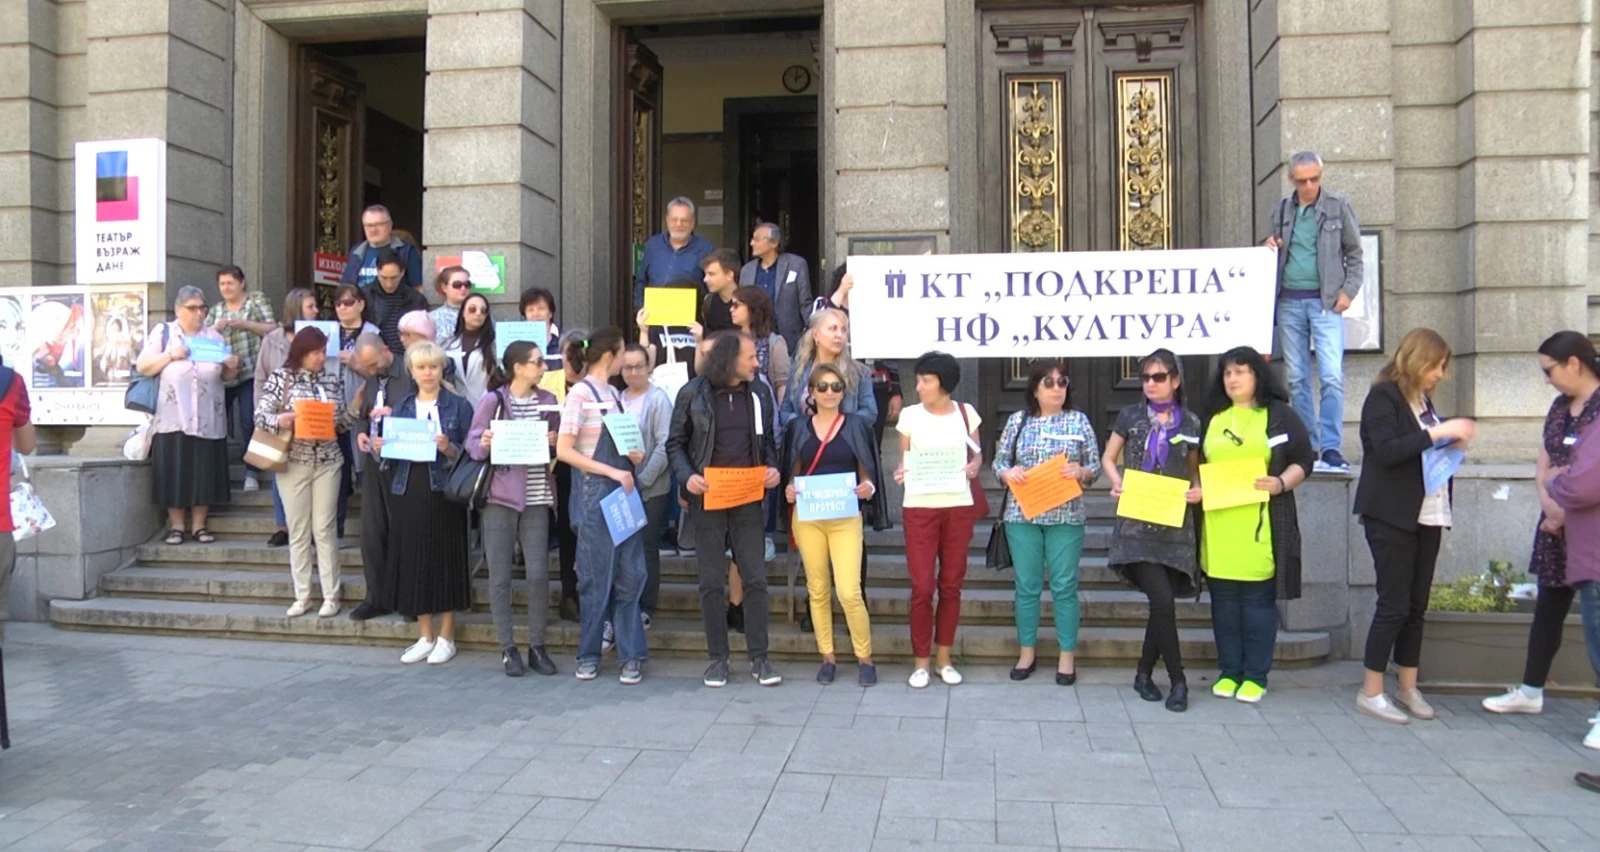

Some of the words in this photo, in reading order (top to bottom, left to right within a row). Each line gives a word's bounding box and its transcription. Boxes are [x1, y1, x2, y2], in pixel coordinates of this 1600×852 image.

[96, 232, 132, 243] ТЕАТЪР
[96, 246, 140, 257] ВЪЗРАЖ
[96, 261, 124, 273] ДАНЕ
[919, 272, 972, 299] КТ
[935, 312, 1001, 347] НФ
[809, 501, 846, 513] ПРОТЕСТ
